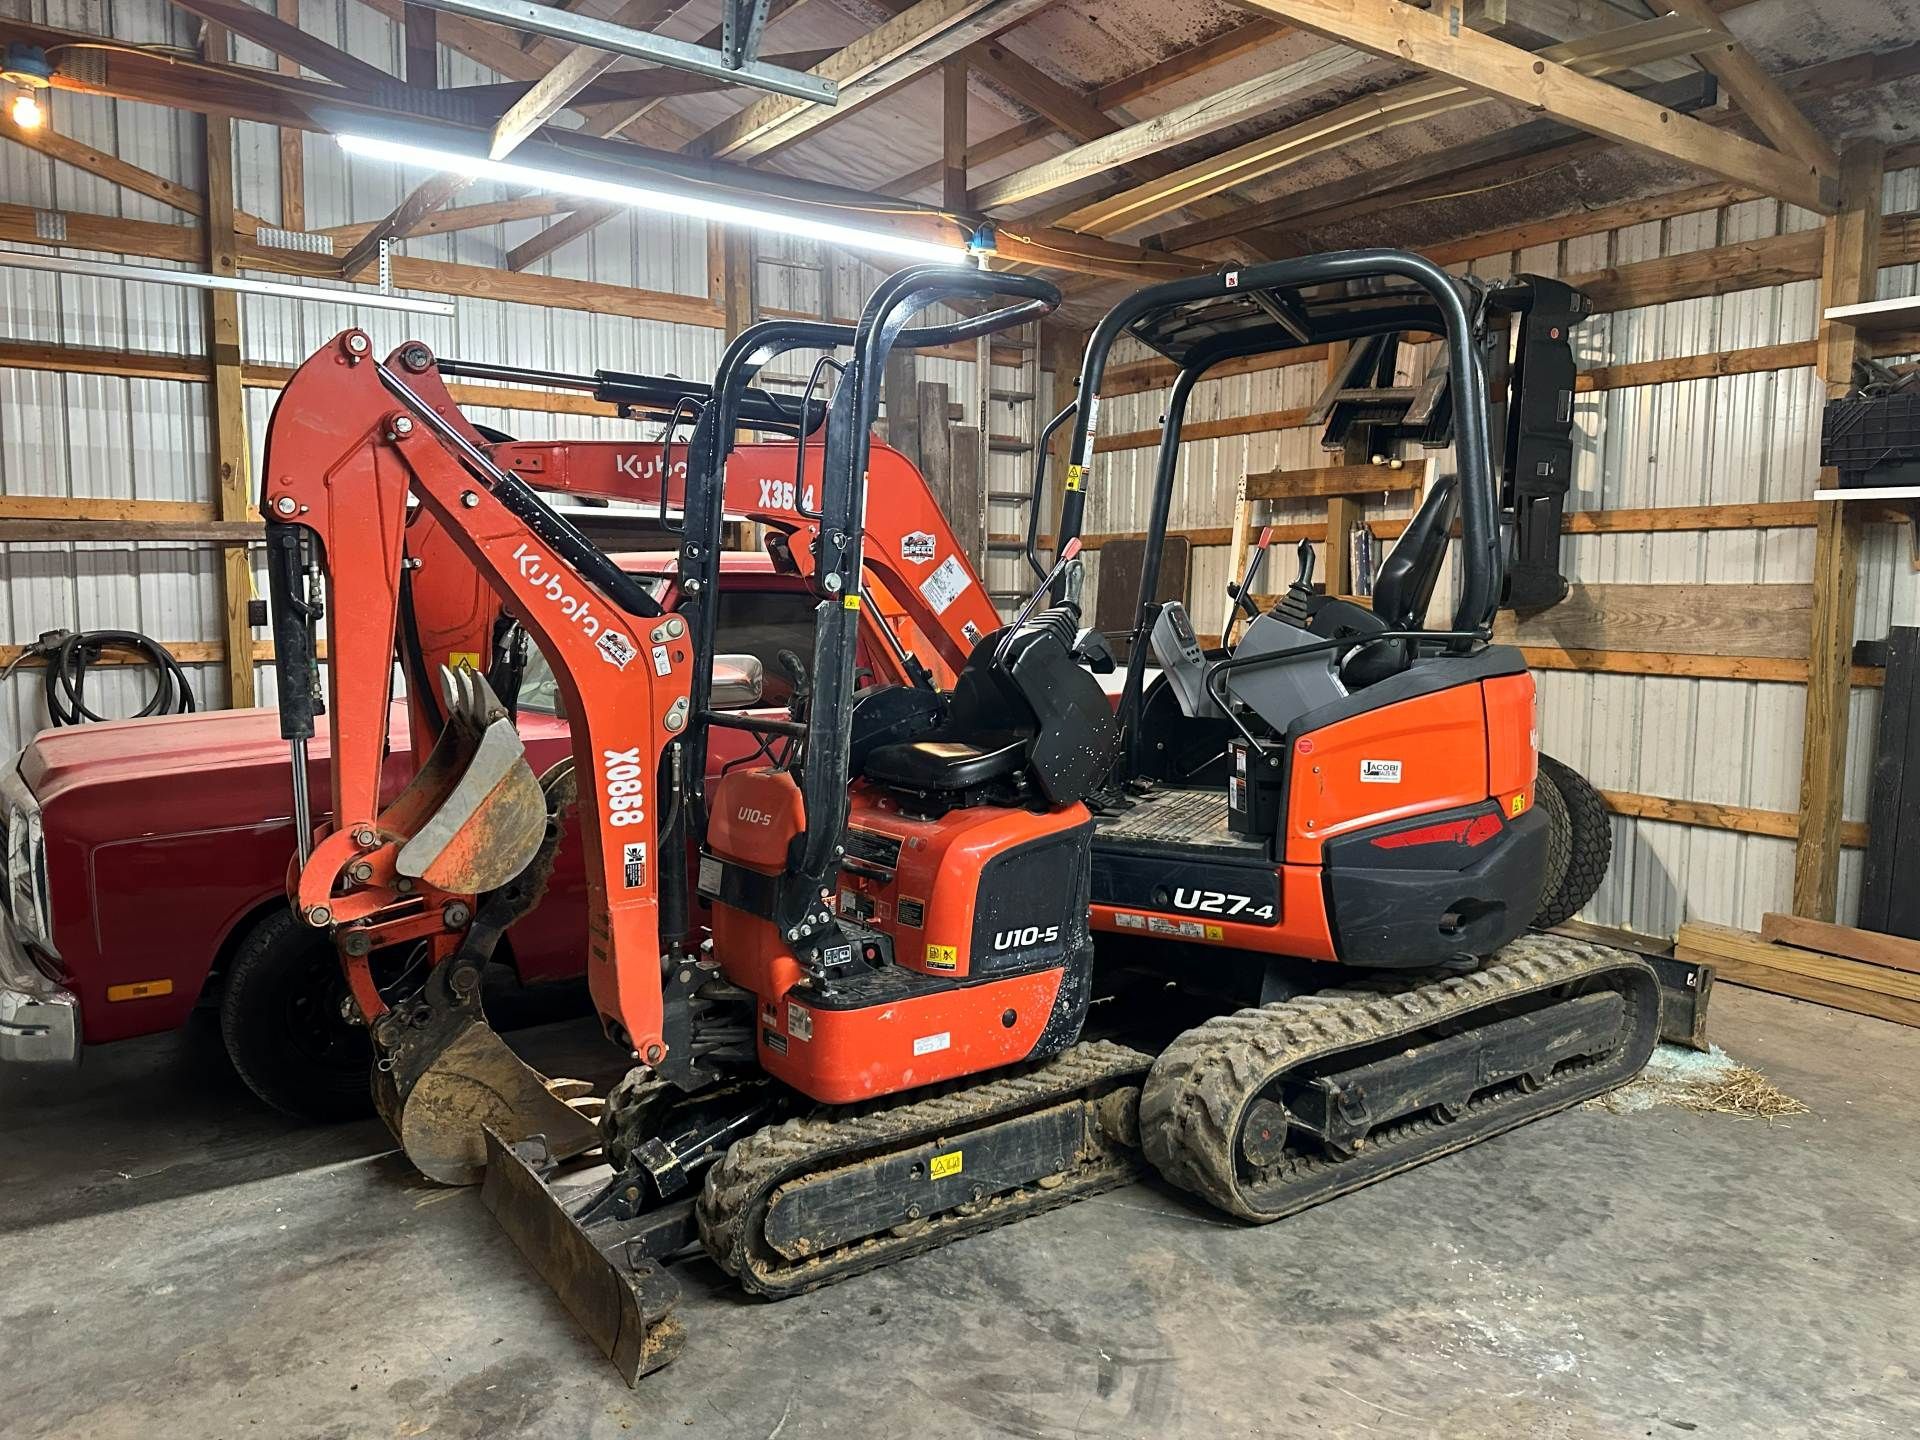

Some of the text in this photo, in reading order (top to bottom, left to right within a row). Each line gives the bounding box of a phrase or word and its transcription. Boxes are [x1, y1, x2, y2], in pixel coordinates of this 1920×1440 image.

[616, 454, 687, 479] Kubo
[758, 478, 814, 512] X354
[512, 543, 599, 637] Kubota
[603, 747, 644, 827] X0858
[737, 806, 772, 826] U10-5
[1173, 887, 1273, 920] U27-4
[994, 925, 1059, 951] U10-5
